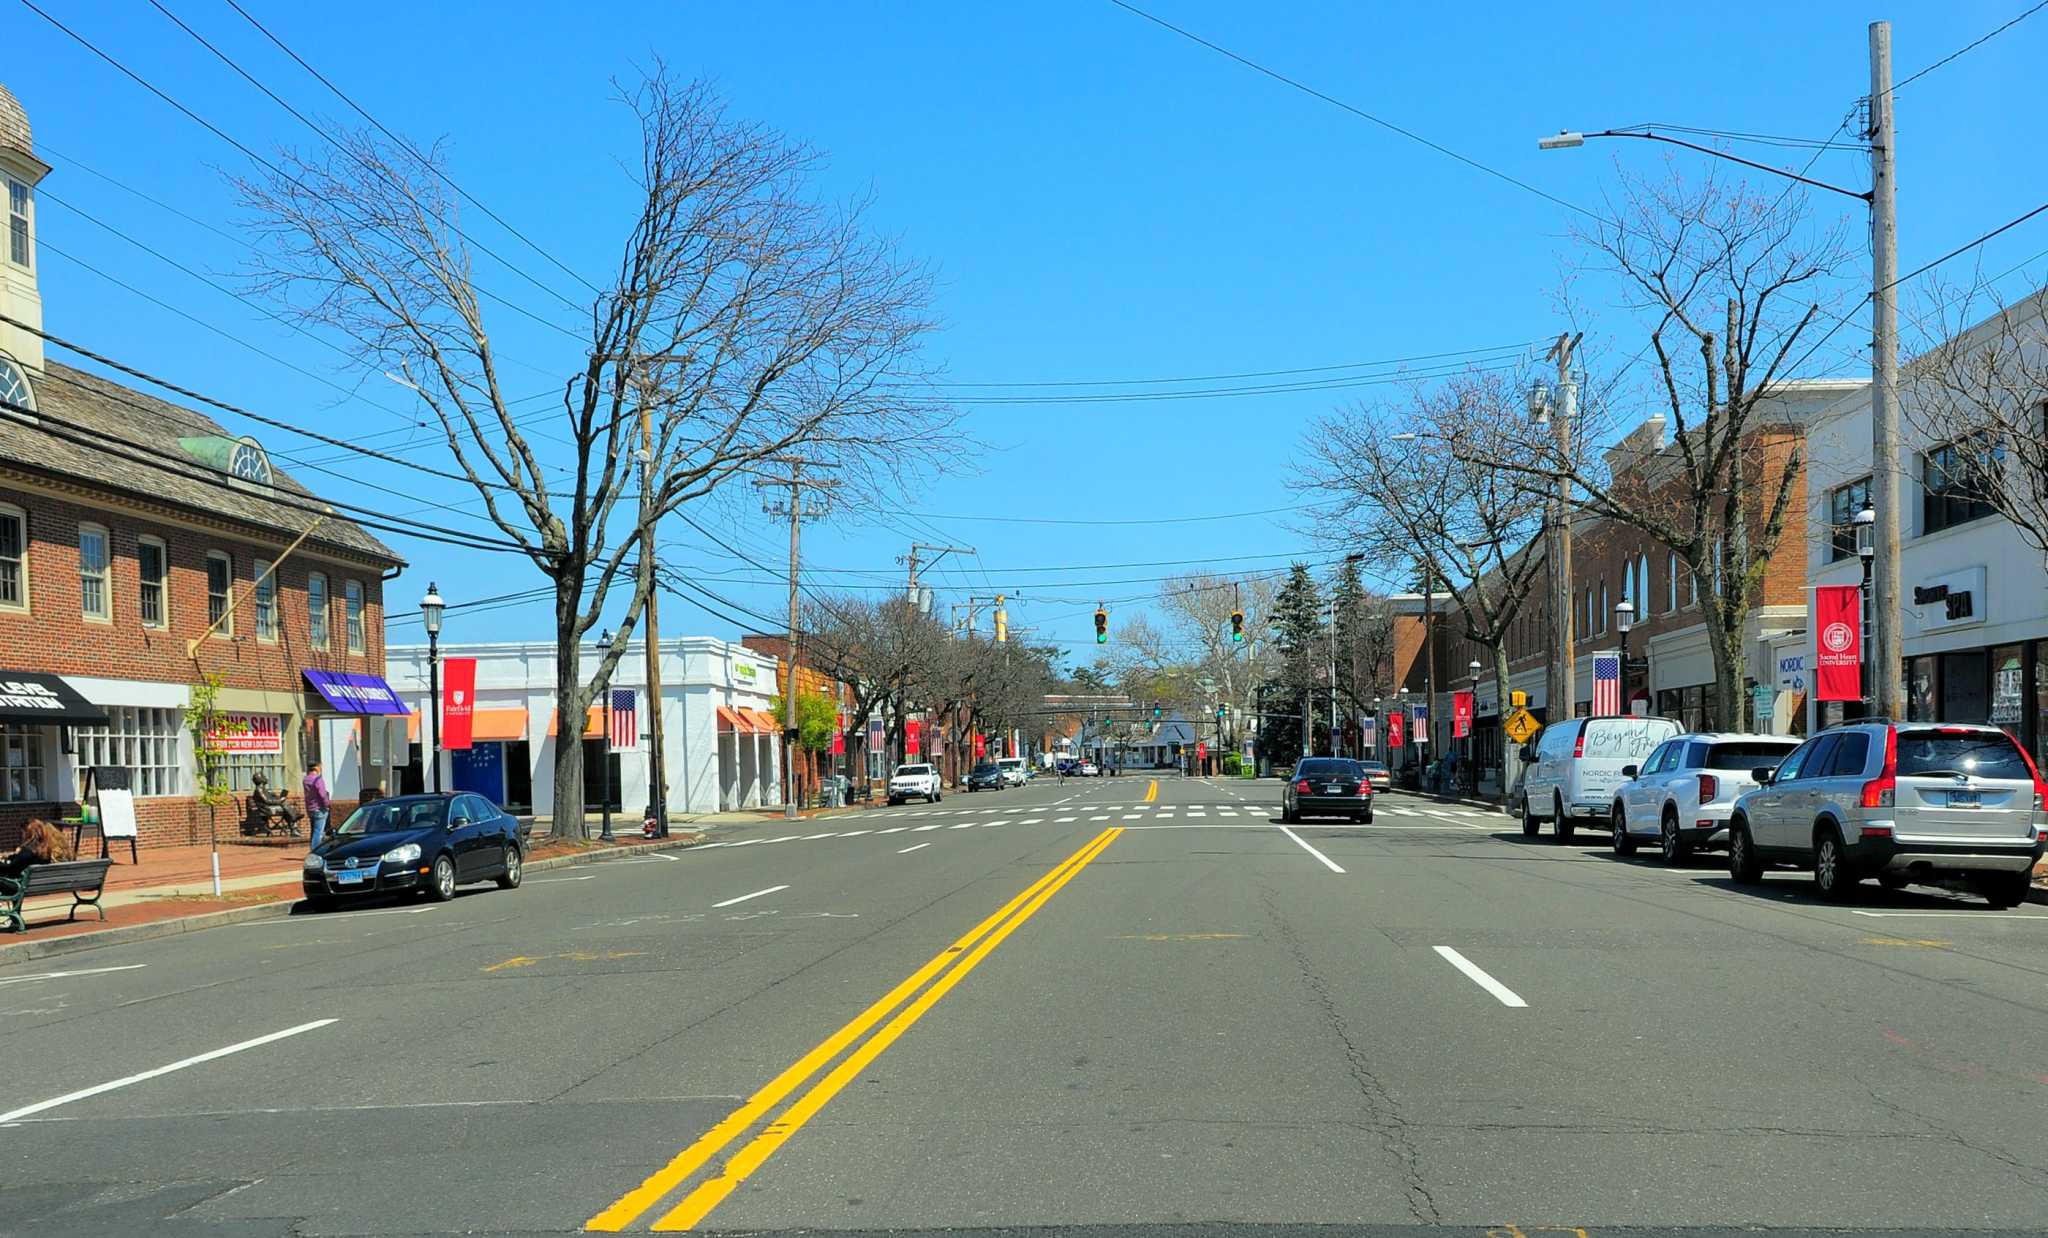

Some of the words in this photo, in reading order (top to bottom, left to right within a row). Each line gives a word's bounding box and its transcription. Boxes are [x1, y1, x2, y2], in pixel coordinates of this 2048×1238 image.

[1946, 591, 1972, 620] SPA
[1780, 655, 1804, 672] NORDIC
[251, 715, 279, 737] SALE
[1582, 769, 1613, 777] NORDIC
